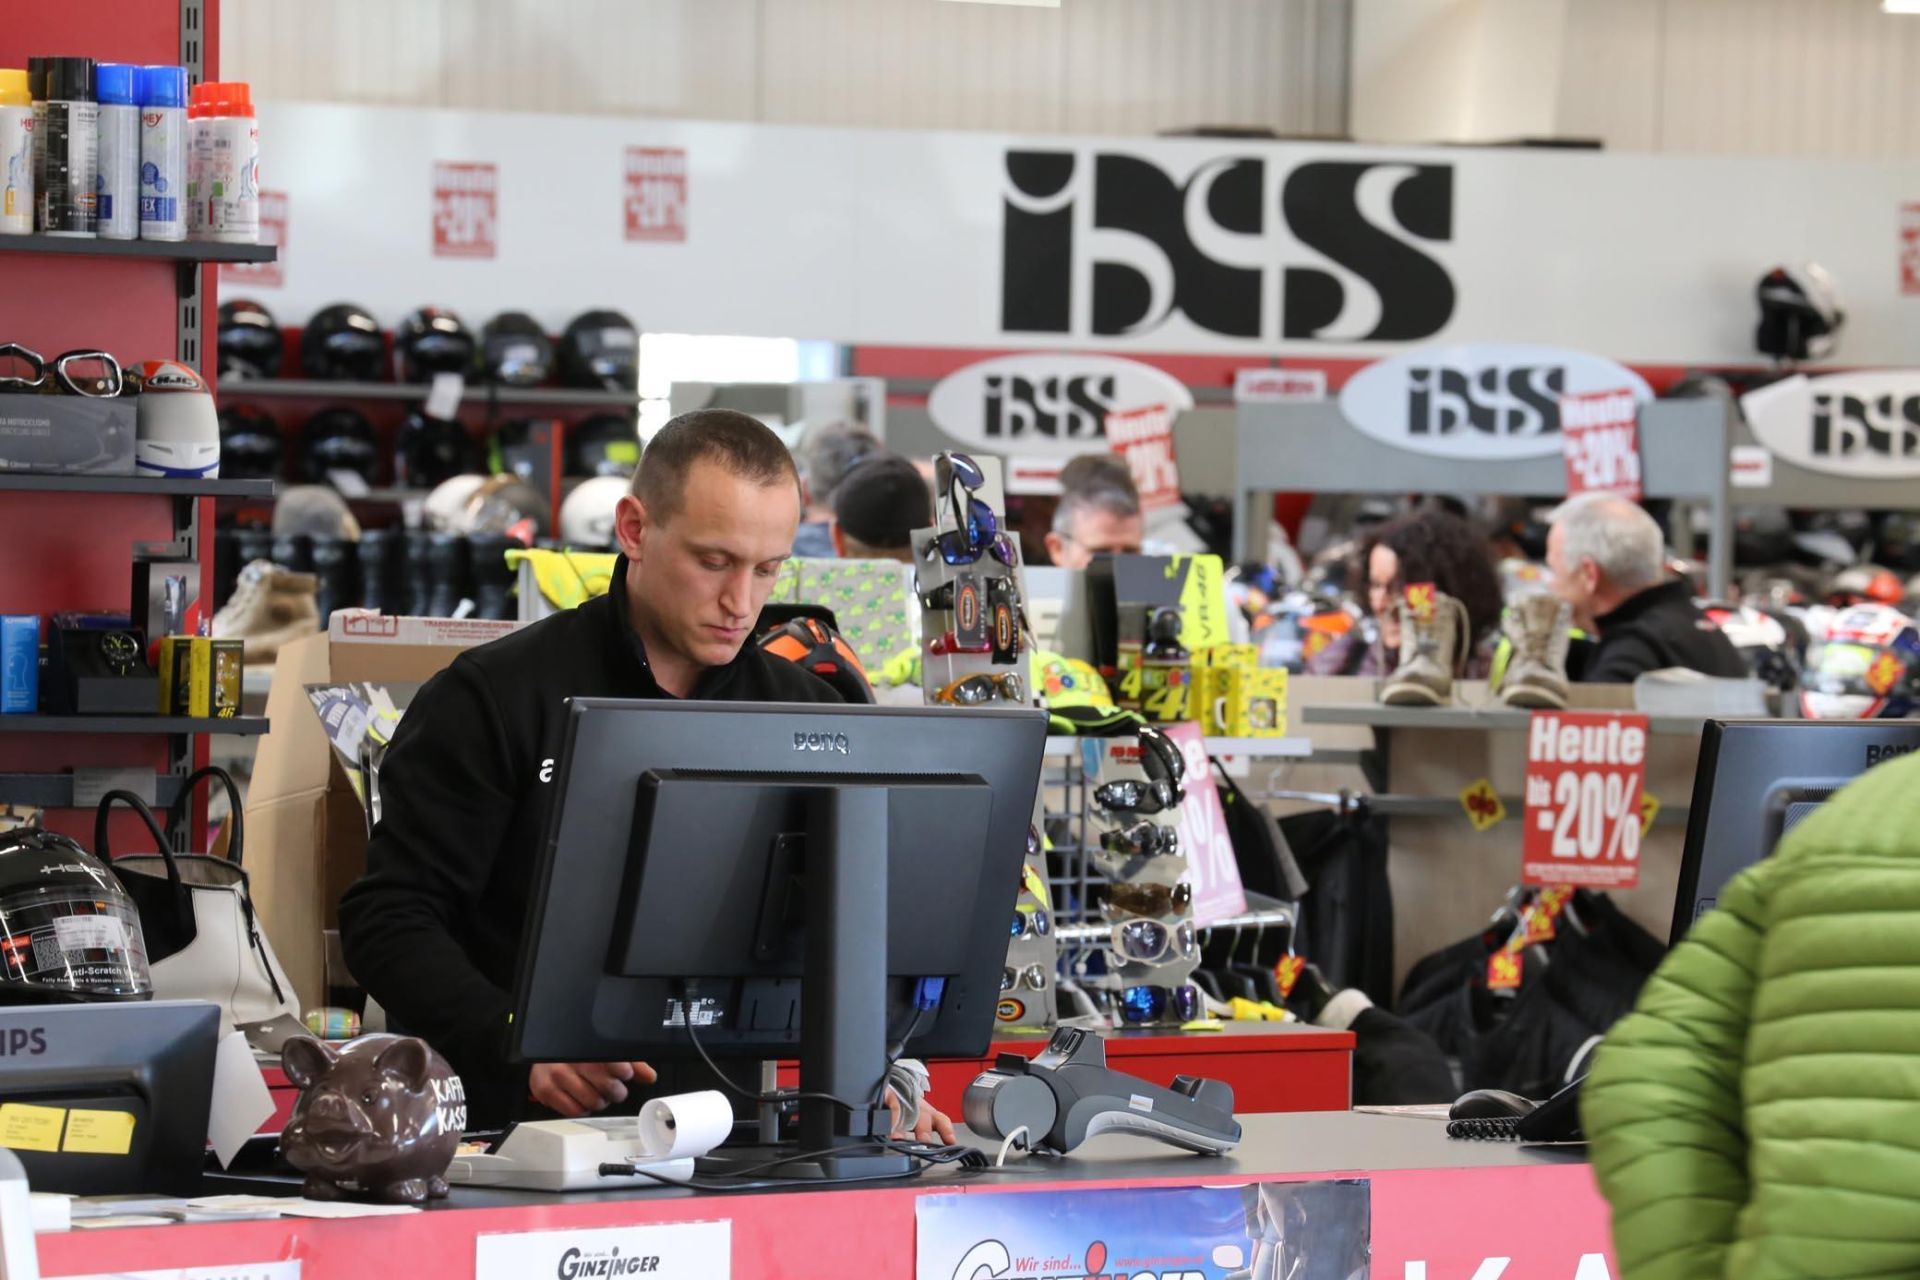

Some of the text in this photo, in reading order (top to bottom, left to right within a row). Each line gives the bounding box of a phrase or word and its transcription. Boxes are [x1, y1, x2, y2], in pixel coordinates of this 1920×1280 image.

[1529, 716, 1645, 765] Heute
[1537, 770, 1640, 861] -20%
[1015, 1254, 1082, 1272] Wir sind...
